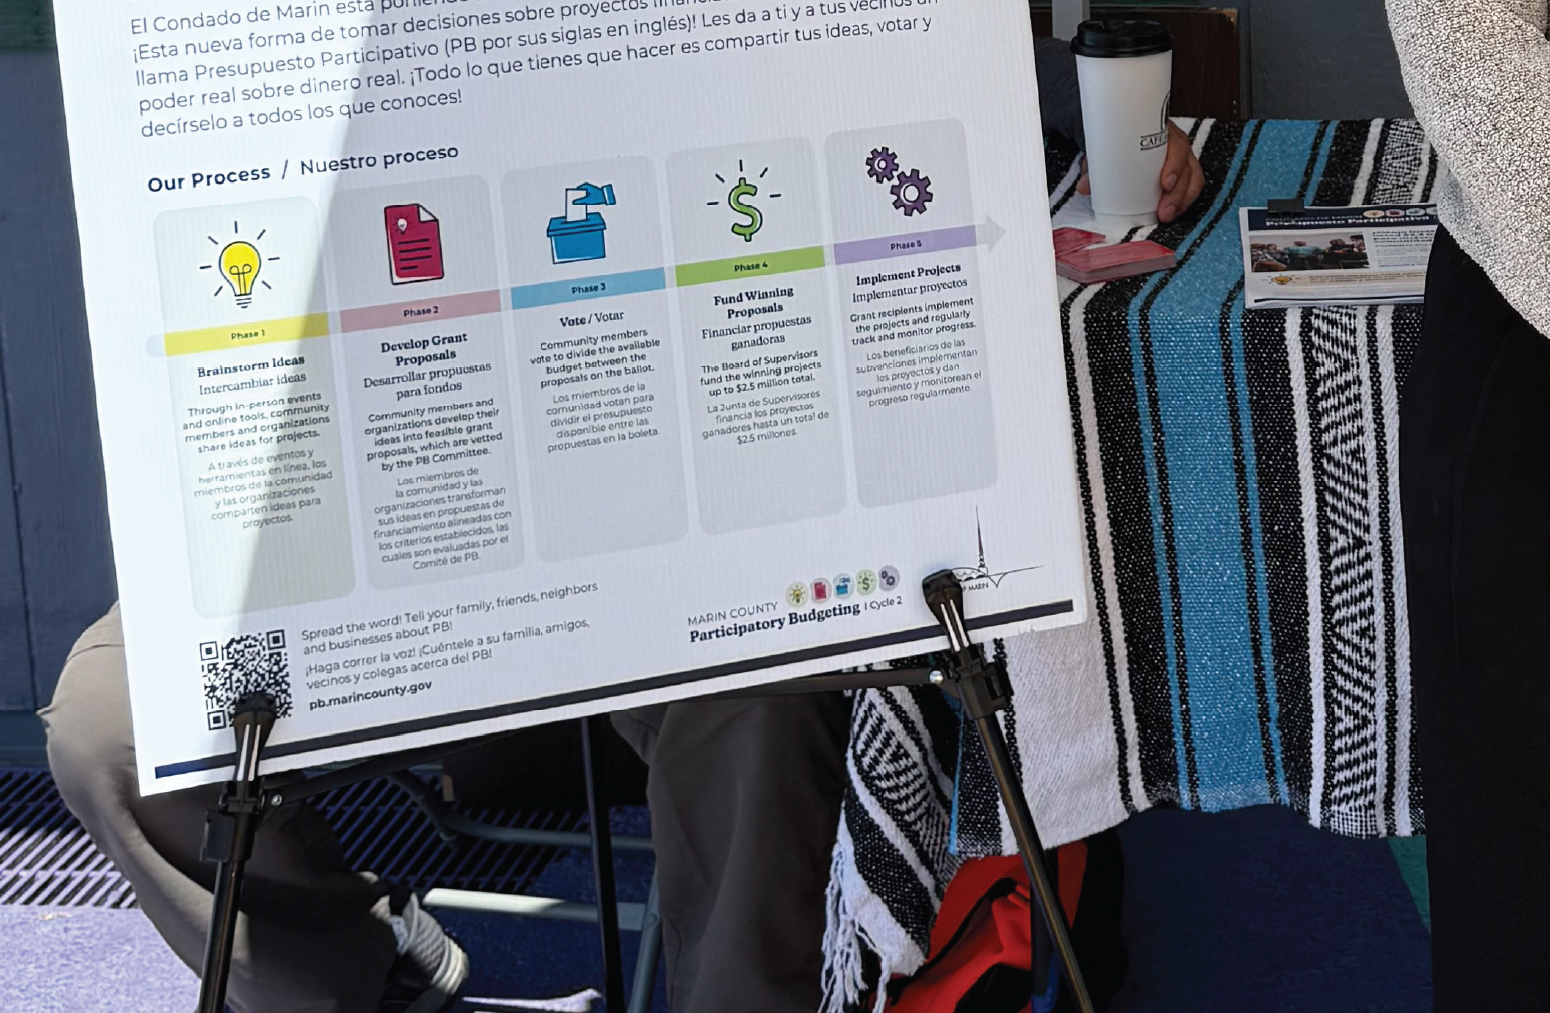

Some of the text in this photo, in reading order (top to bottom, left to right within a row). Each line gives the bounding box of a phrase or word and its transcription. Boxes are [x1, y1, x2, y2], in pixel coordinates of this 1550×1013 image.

[131, 17, 147, 35] El
[153, 9, 241, 33] Condado
[246, 6, 271, 23] de
[276, 0, 330, 20] Marin
[147, 177, 185, 193] Our
[191, 167, 271, 189] Process
[300, 156, 377, 175] Nuestro
[383, 147, 459, 170] proceso
[734, 263, 761, 273] Phase
[856, 264, 962, 286] Implement Projects
[713, 287, 794, 306] Fund Winning
[559, 316, 587, 328] Vote
[594, 311, 625, 323] Votar
[727, 302, 784, 320] Proposals
[380, 333, 468, 354] Develop Grant
[731, 334, 786, 351] ganadoras
[197, 356, 305, 378] Brainstorm Ideas
[395, 348, 457, 367] Proposals
[687, 601, 778, 627] MARIN COUNTY
[690, 602, 860, 642] Participatory Budgeting
[309, 681, 432, 711] pb.marincounty.gov
